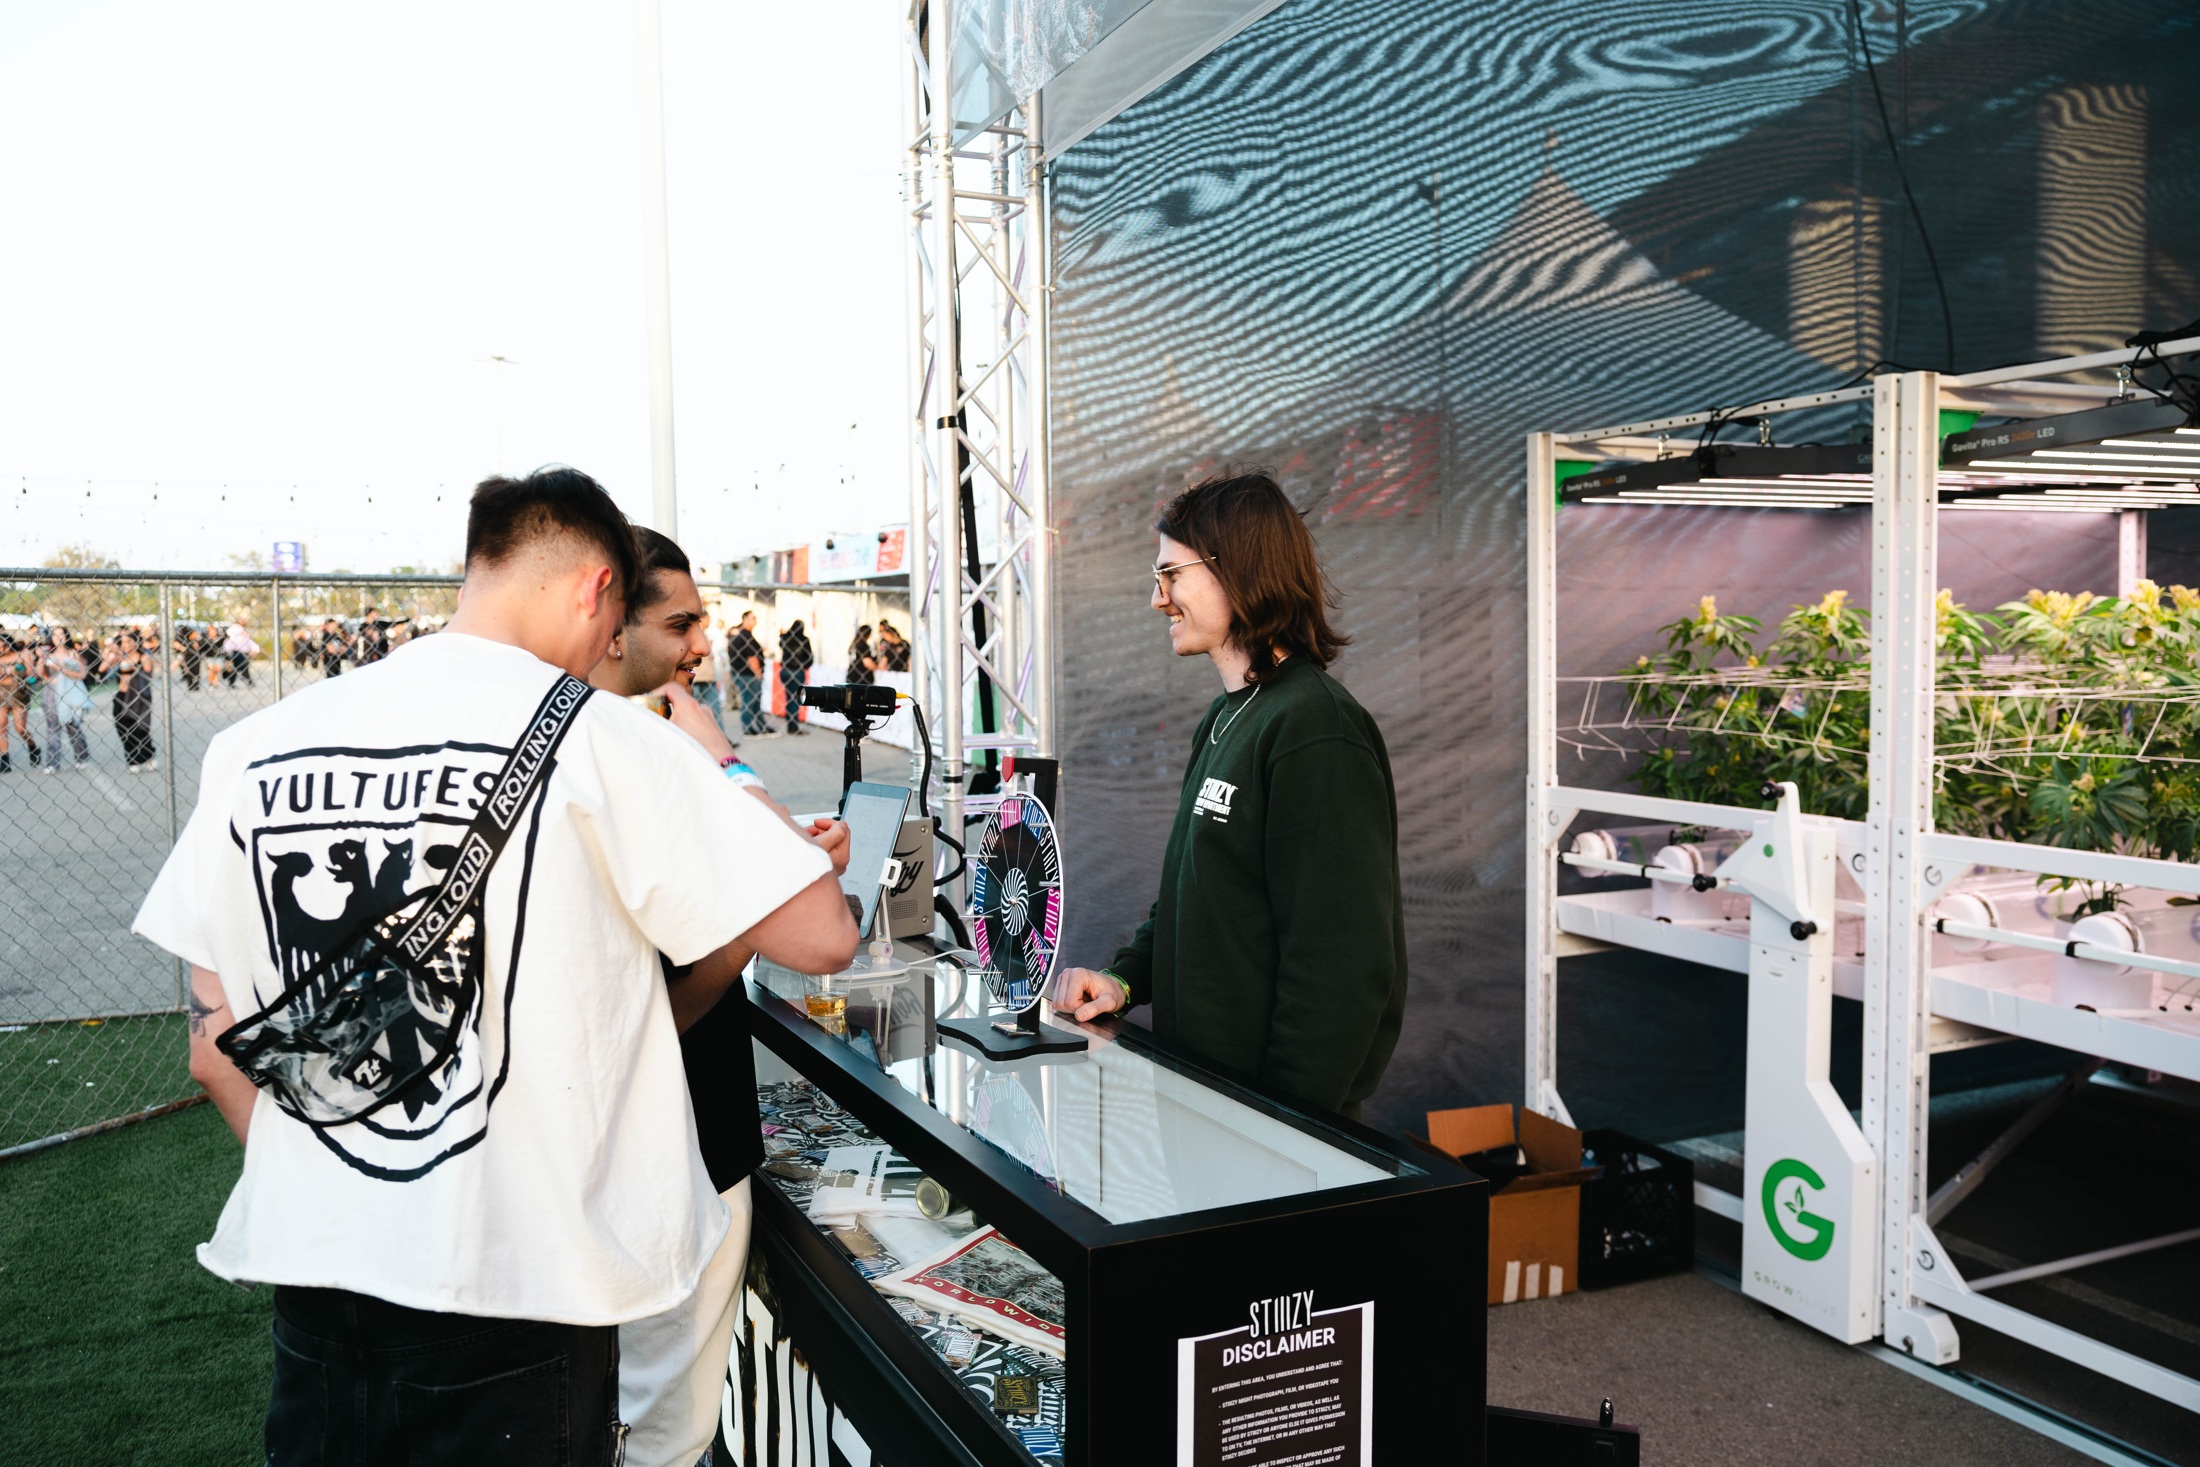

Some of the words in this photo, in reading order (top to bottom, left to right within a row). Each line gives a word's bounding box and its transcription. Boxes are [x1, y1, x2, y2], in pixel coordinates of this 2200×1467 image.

[2037, 427, 2055, 438] LED
[496, 717, 558, 816] ROLLING
[550, 681, 583, 719] LOUD
[441, 845, 485, 914] LOUD
[1250, 1290, 1314, 1338] STIIIZY
[1222, 1327, 1336, 1367] DISCLAIMER
[1218, 1381, 1240, 1391] ENTERING
[1275, 1367, 1305, 1378] UNDERSTAND
[1315, 1362, 1329, 1370] AGREE
[1238, 1396, 1253, 1404] MIGHT
[1305, 1380, 1329, 1389] VIDEOTAPE
[1231, 1413, 1255, 1423] RESULTING
[1232, 1423, 1247, 1432] OTHER
[1247, 1416, 1278, 1428] INFORMATION
[1288, 1410, 1308, 1419] PROVIDE
[1270, 1423, 1288, 1431] ANYONE
[1289, 1420, 1299, 1428] ELSE
[1305, 1416, 1318, 1424] GIVES
[1318, 1411, 1345, 1421] PERMISSION
[1299, 1426, 1313, 1434] OTHER
[1238, 1447, 1256, 1457] DECIDES
[1276, 1456, 1295, 1465] INSPECT
[1303, 1450, 1323, 1459] APPROVE
[1323, 1447, 1333, 1455] ANY
[1333, 1445, 1345, 1453] SUCH
[1321, 1456, 1334, 1464] MADE
